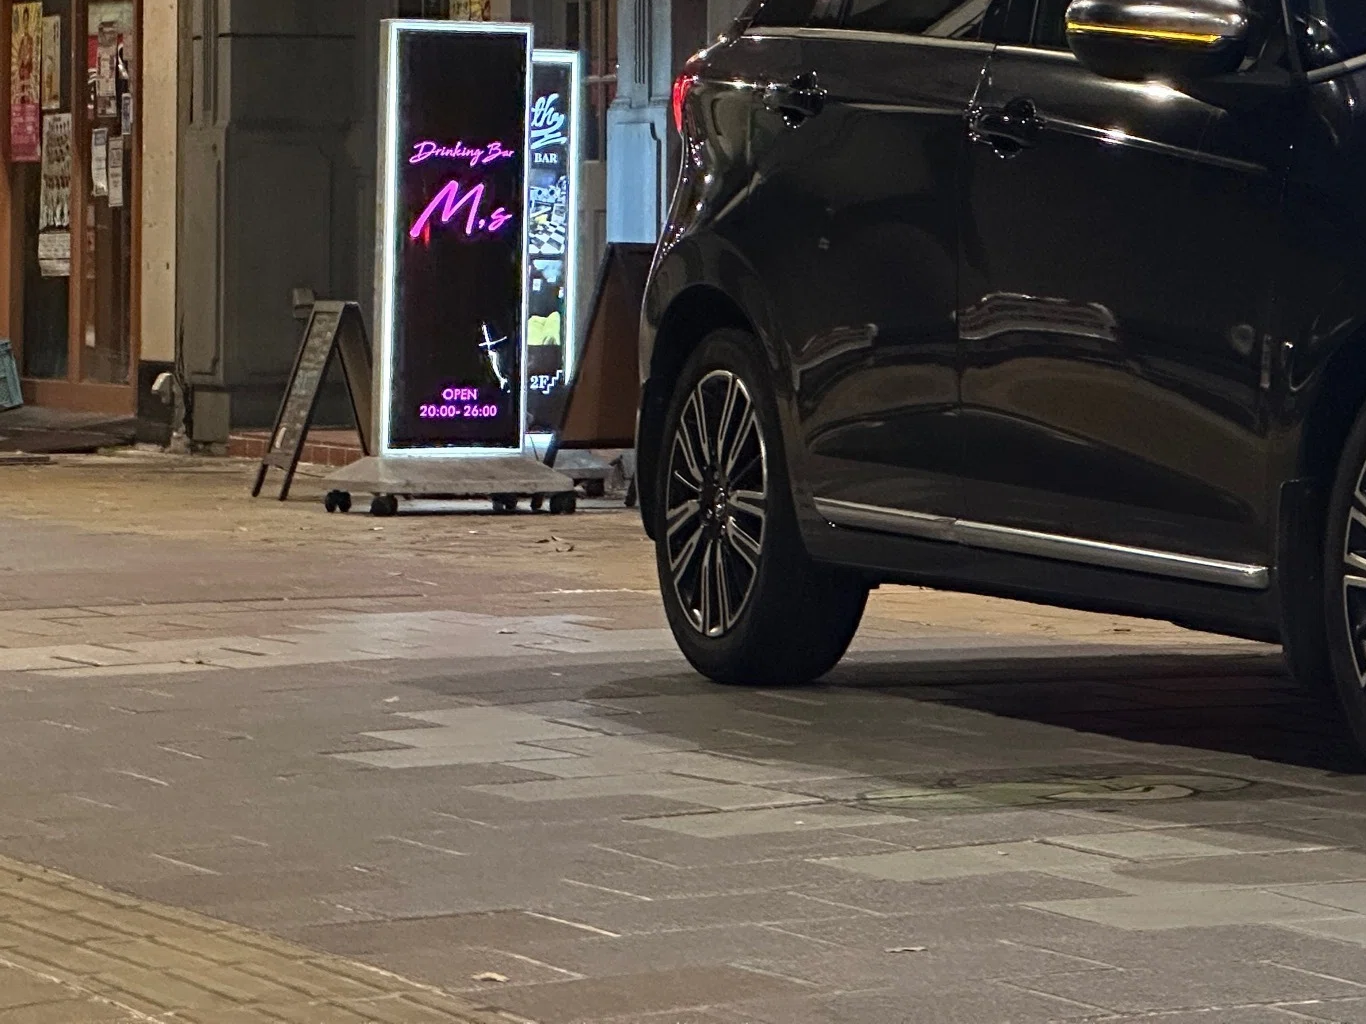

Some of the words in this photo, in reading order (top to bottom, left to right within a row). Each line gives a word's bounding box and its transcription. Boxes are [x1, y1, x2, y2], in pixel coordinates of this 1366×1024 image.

[408, 140, 485, 167] Drinking
[482, 141, 514, 163] Bar
[534, 152, 558, 163] BAR
[529, 375, 549, 389] 2F
[441, 388, 478, 401] OPEN
[463, 405, 498, 417] 26:00
